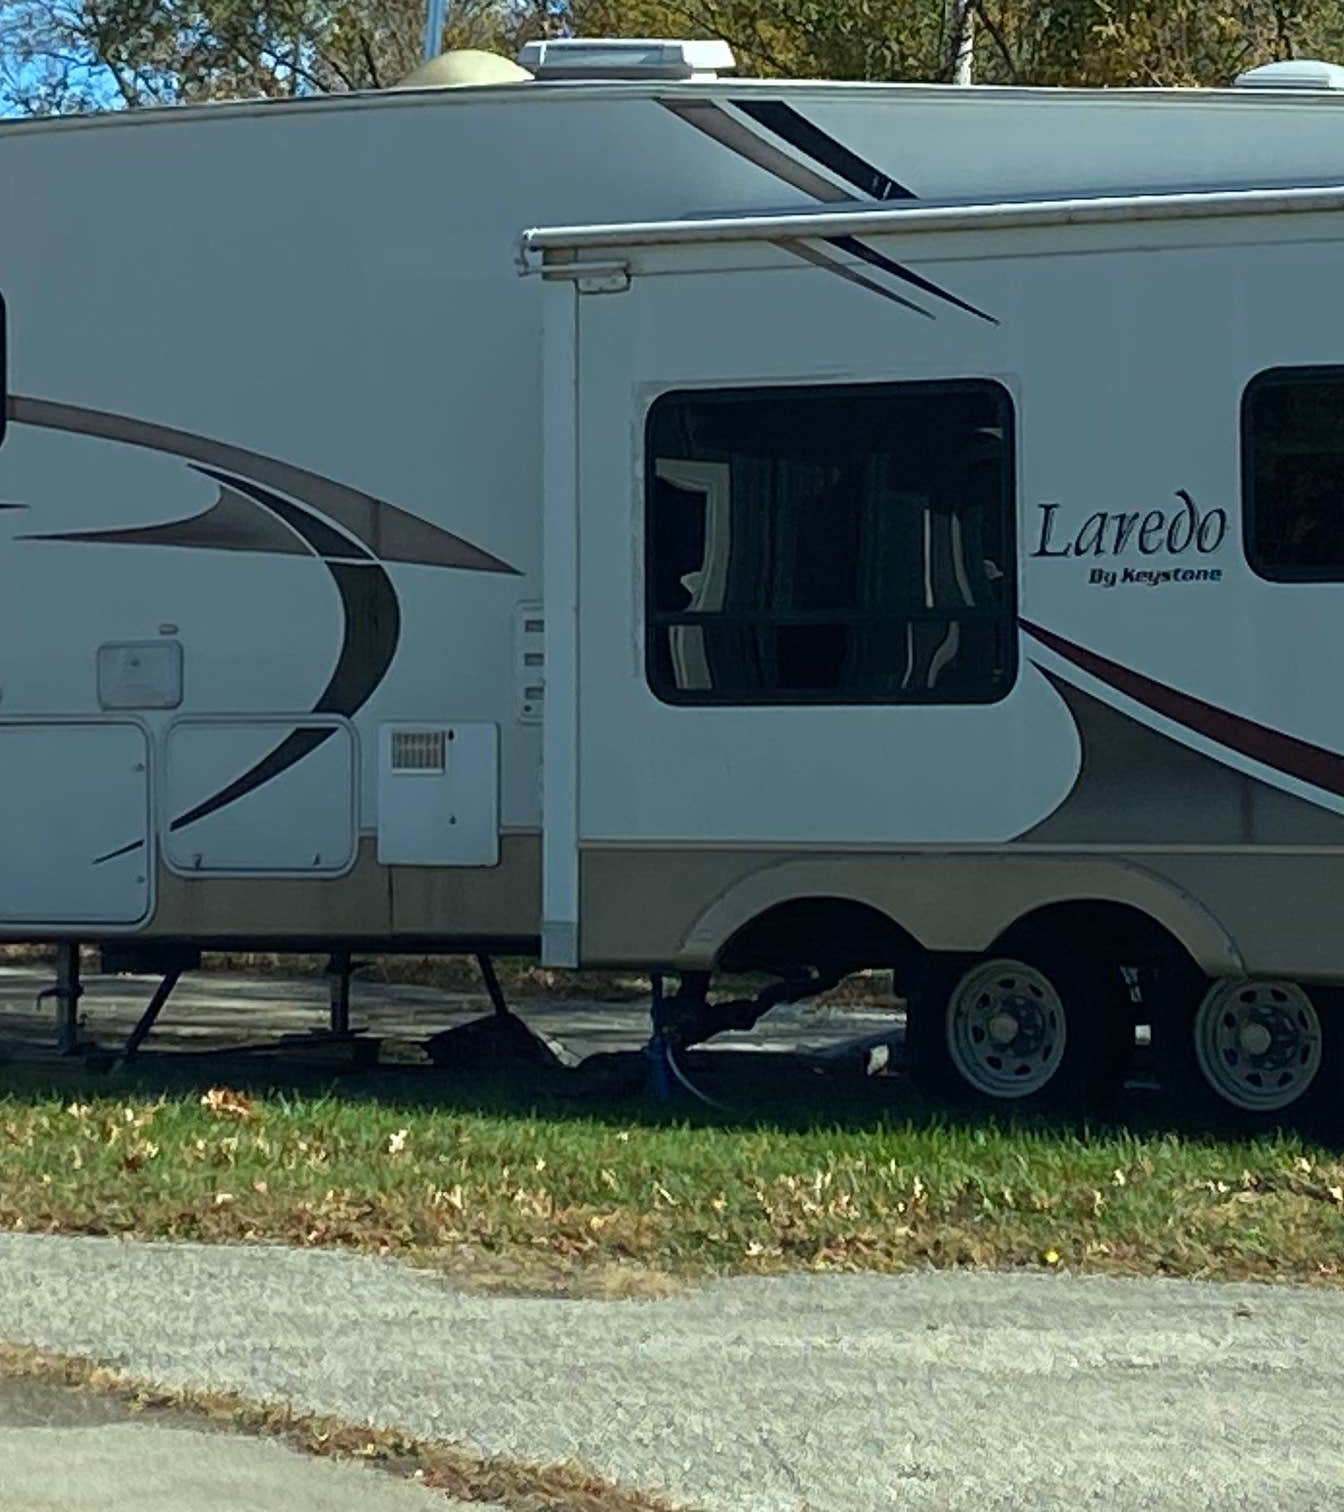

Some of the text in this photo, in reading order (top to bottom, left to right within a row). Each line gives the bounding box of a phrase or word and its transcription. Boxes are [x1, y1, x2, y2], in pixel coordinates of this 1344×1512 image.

[1029, 488, 1228, 558] Laredo
[1088, 567, 1222, 587] By Keystone
